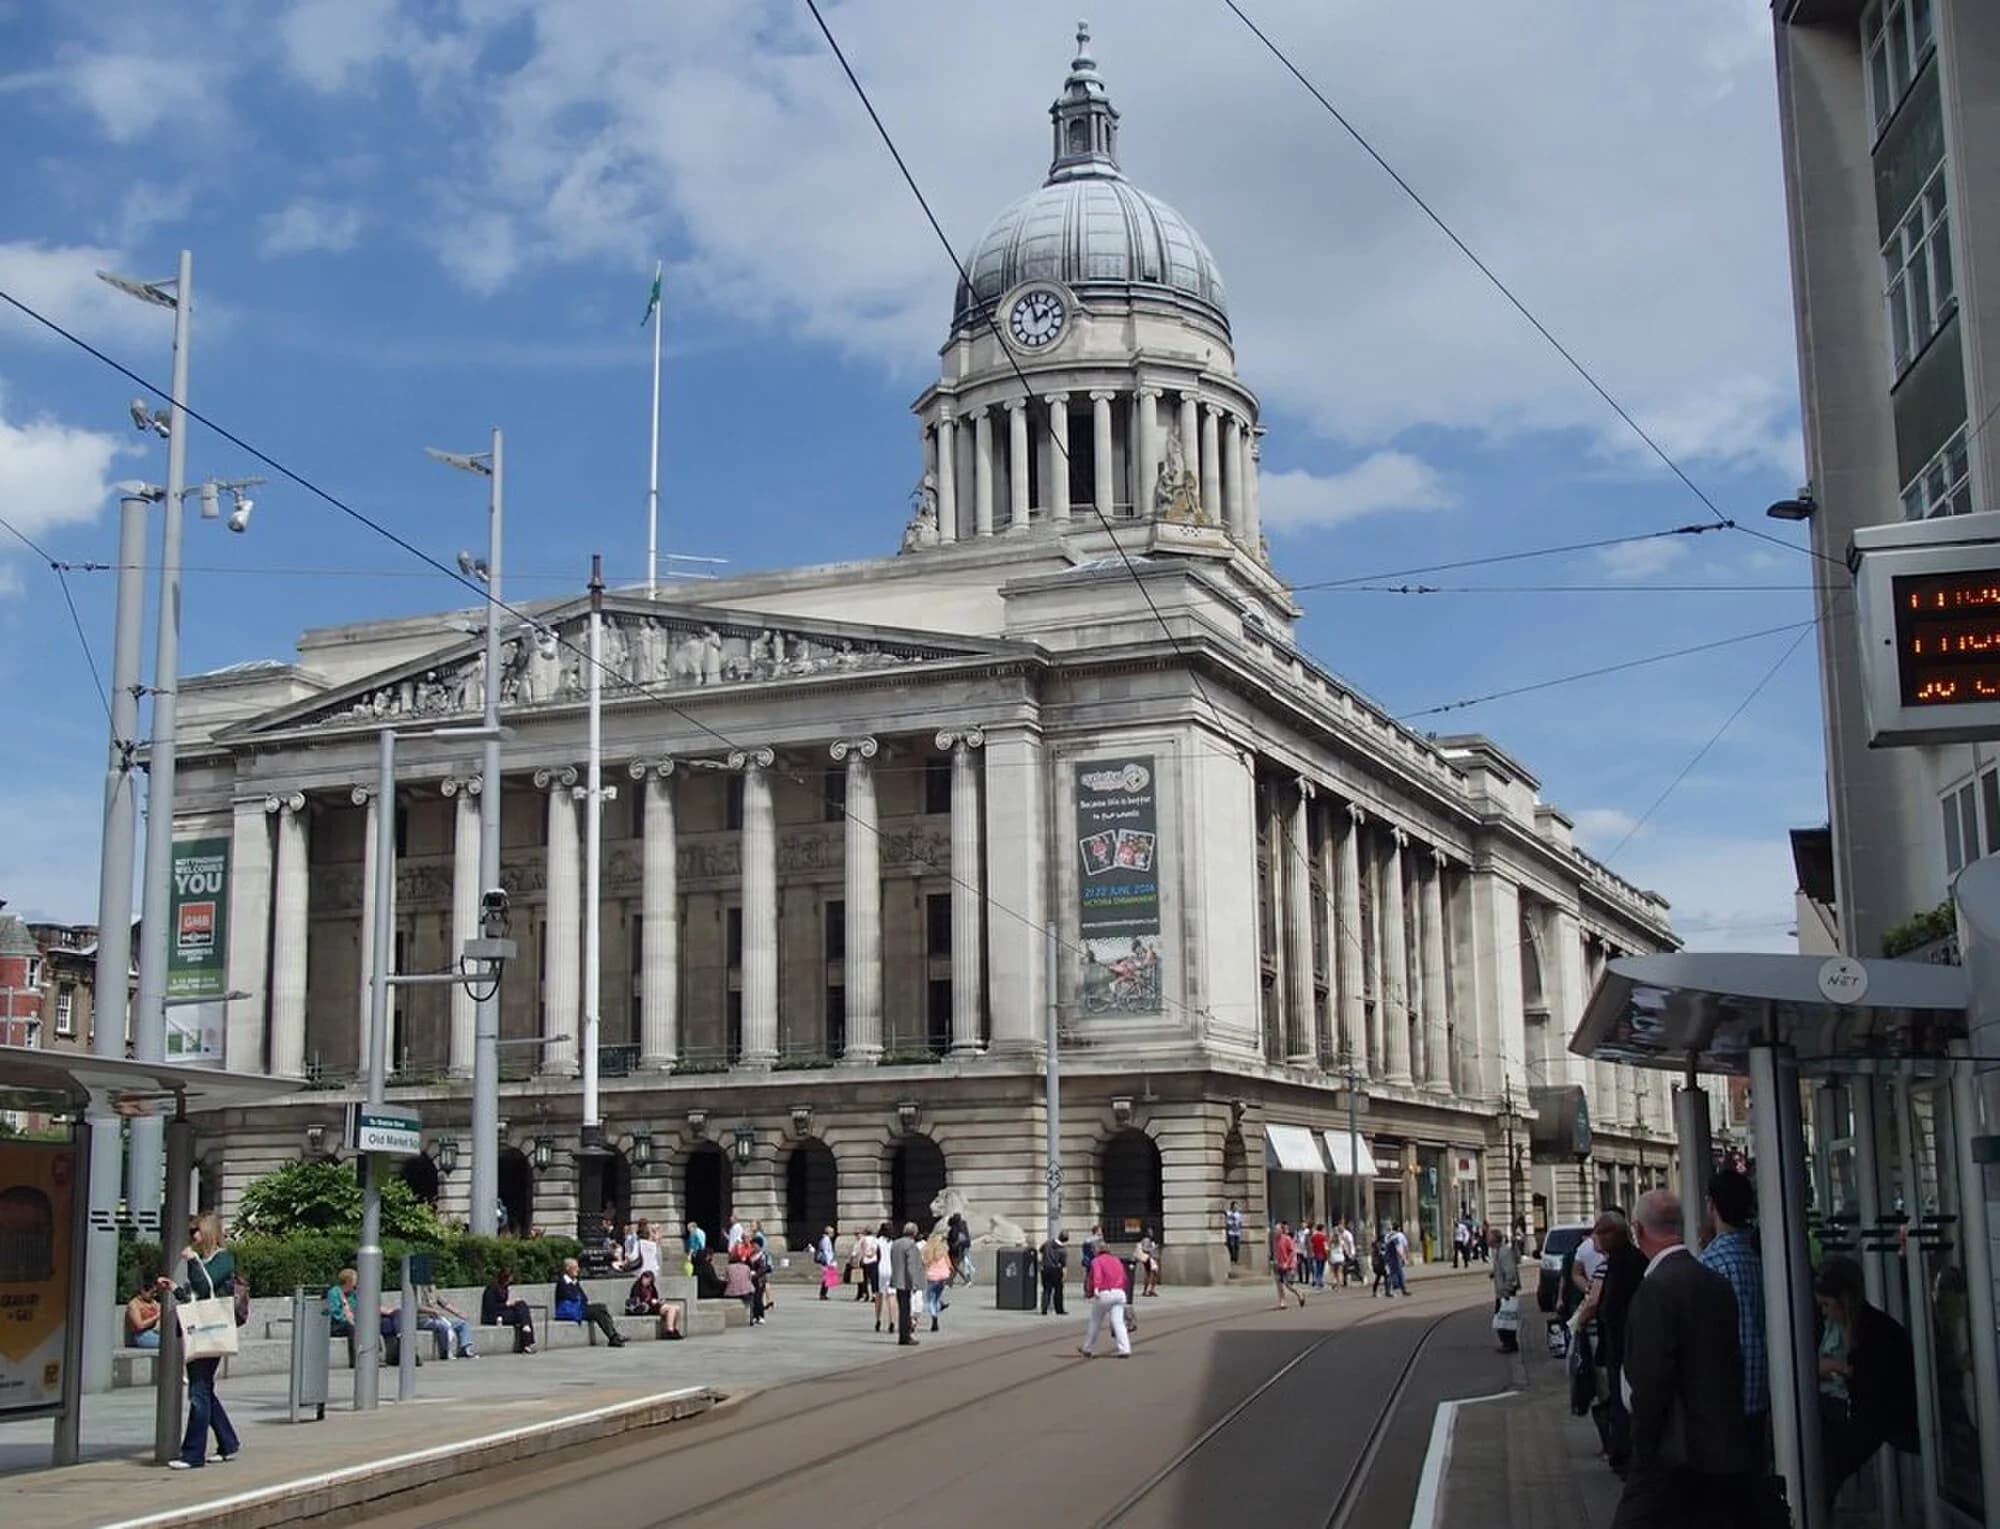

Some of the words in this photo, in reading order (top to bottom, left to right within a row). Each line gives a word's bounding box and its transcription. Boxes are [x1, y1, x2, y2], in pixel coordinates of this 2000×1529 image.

[174, 872, 222, 895] YOU
[1827, 975, 1859, 986] NET
[368, 1132, 385, 1145] Old
